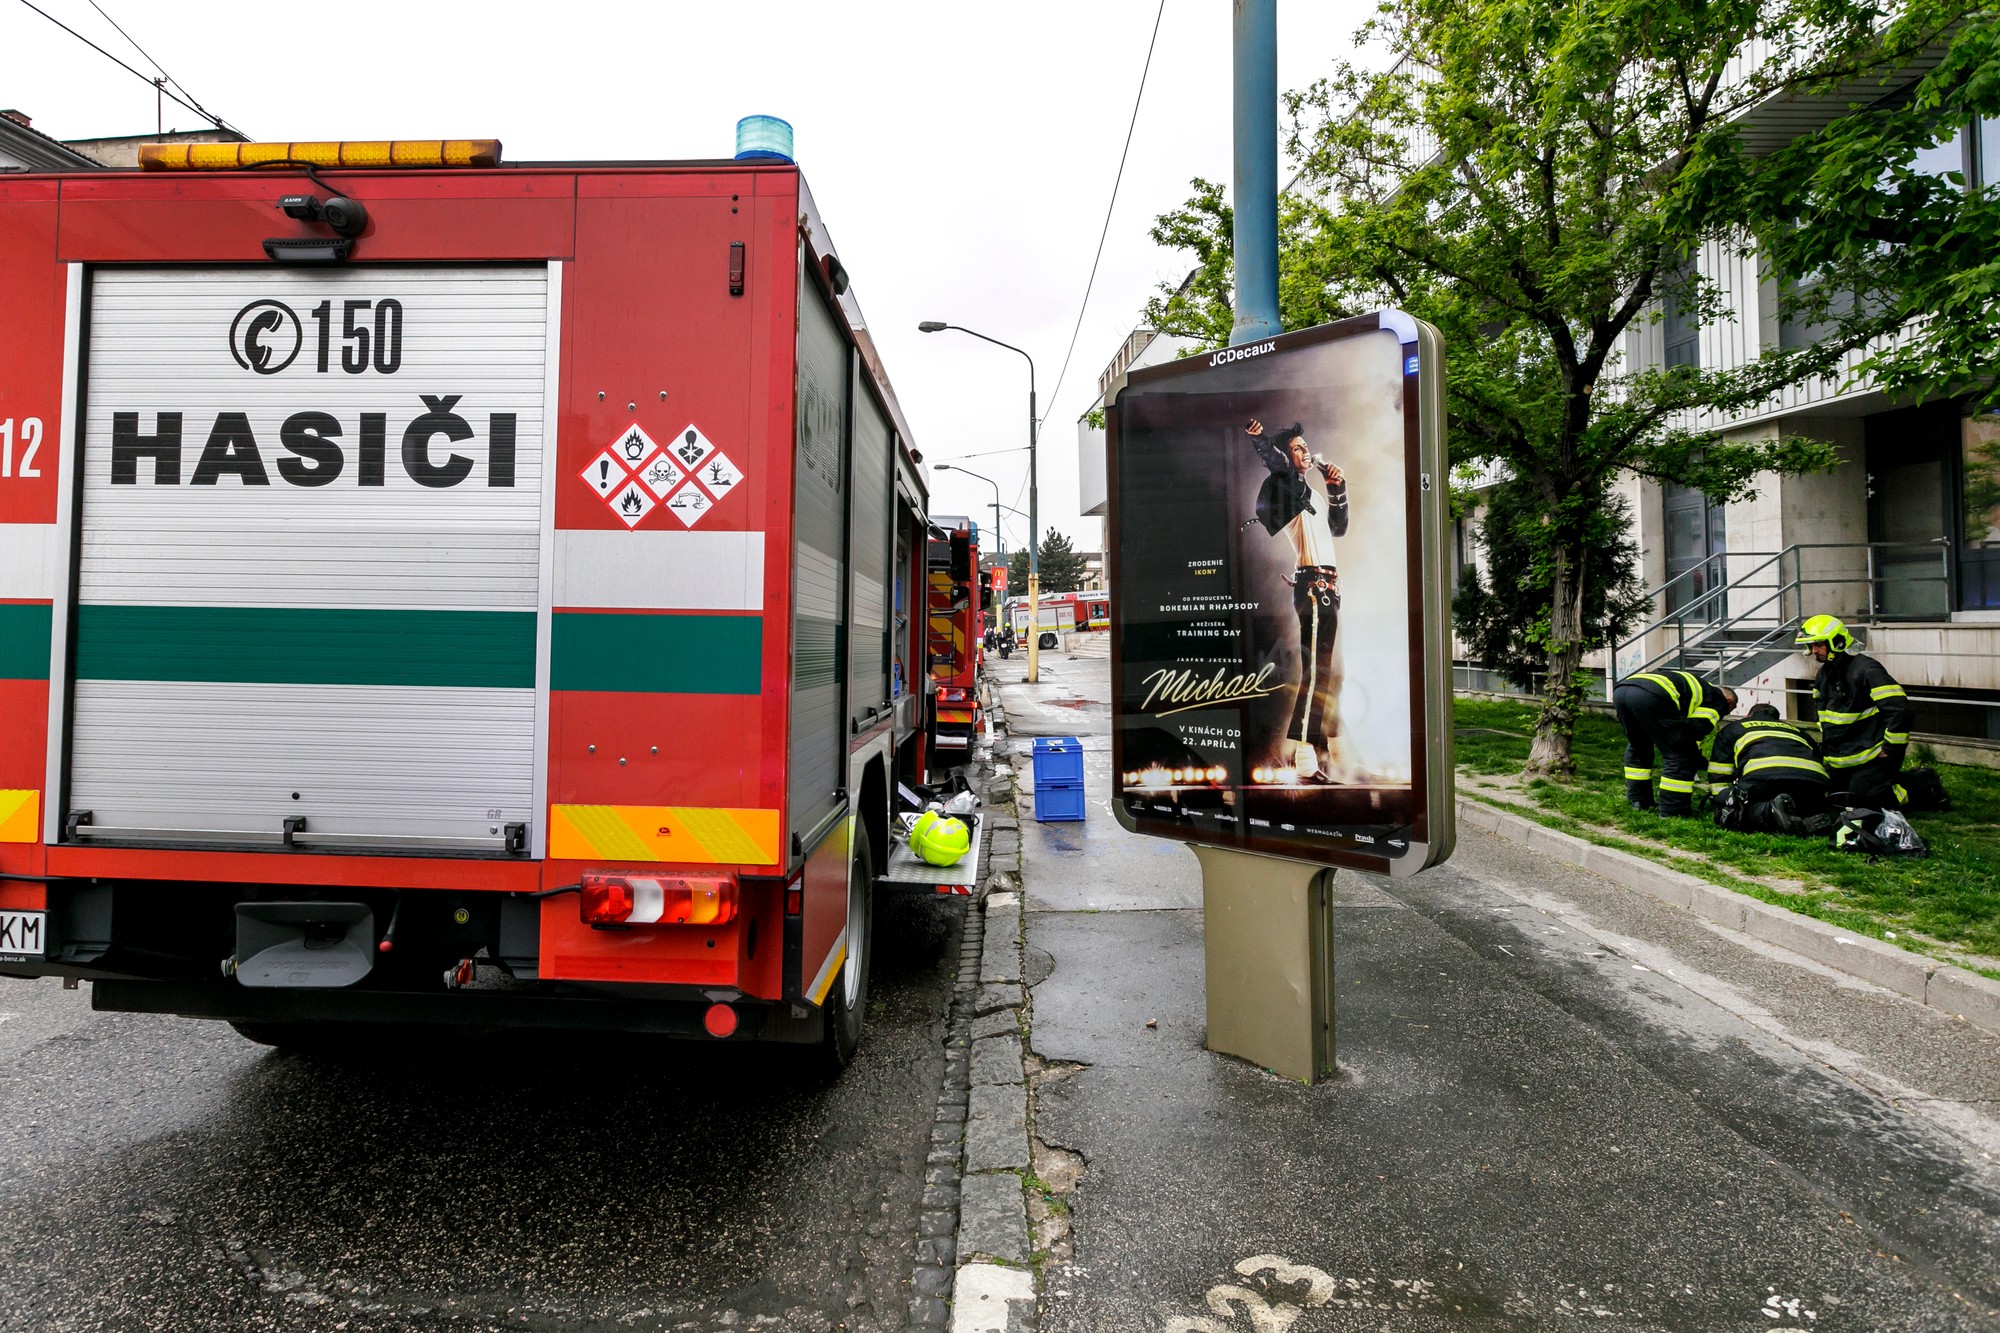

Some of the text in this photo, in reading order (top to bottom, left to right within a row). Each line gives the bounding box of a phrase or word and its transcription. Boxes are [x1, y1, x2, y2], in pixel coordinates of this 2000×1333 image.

[311, 298, 403, 375] 150
[1209, 341, 1276, 367] JCDecaux
[110, 394, 517, 488] HASIČI
[1187, 559, 1224, 568] ZRODENIE
[1159, 602, 1260, 612] BOHEMIAN RHAPSODY
[1223, 629, 1242, 637] DAY
[1140, 661, 1286, 711] Michael
[1179, 725, 1241, 738] V KINÁCH OD
[1182, 737, 1236, 750] 22. APRÍLA
